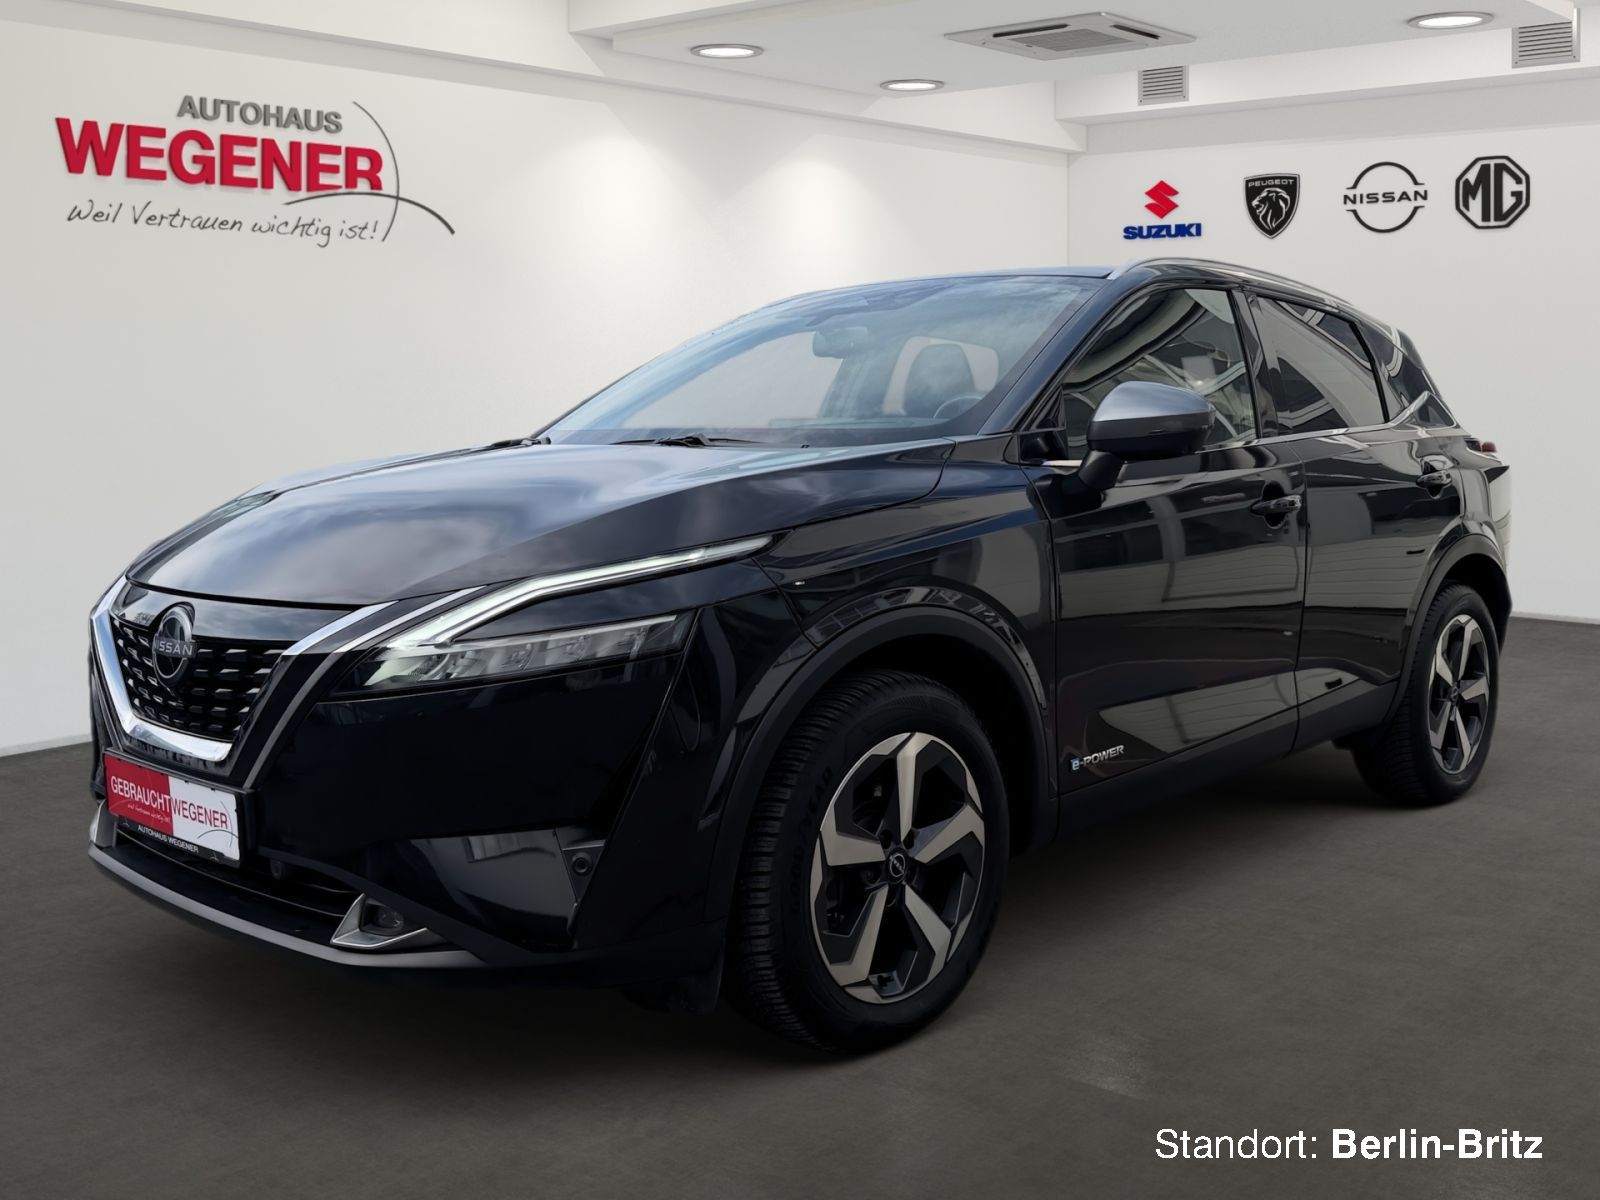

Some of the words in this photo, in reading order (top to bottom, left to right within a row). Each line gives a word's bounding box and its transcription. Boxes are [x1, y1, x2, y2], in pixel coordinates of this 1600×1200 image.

[177, 95, 342, 134] AUTOHAUS
[55, 117, 384, 193] WEGENER
[1248, 178, 1295, 188] PEUGEOT
[1343, 189, 1428, 206] NISSAN
[1461, 163, 1524, 222] MG
[67, 199, 123, 223] Weil
[131, 200, 242, 233] Vertrauen
[250, 212, 332, 248] wichtig
[338, 220, 379, 241] ist!
[1123, 223, 1202, 240] SUZUKI
[110, 775, 171, 813] GEBRAUCHT
[171, 798, 228, 830] WEGENER
[137, 824, 168, 843] AUTOHAUS
[168, 837, 200, 854] WEGENER
